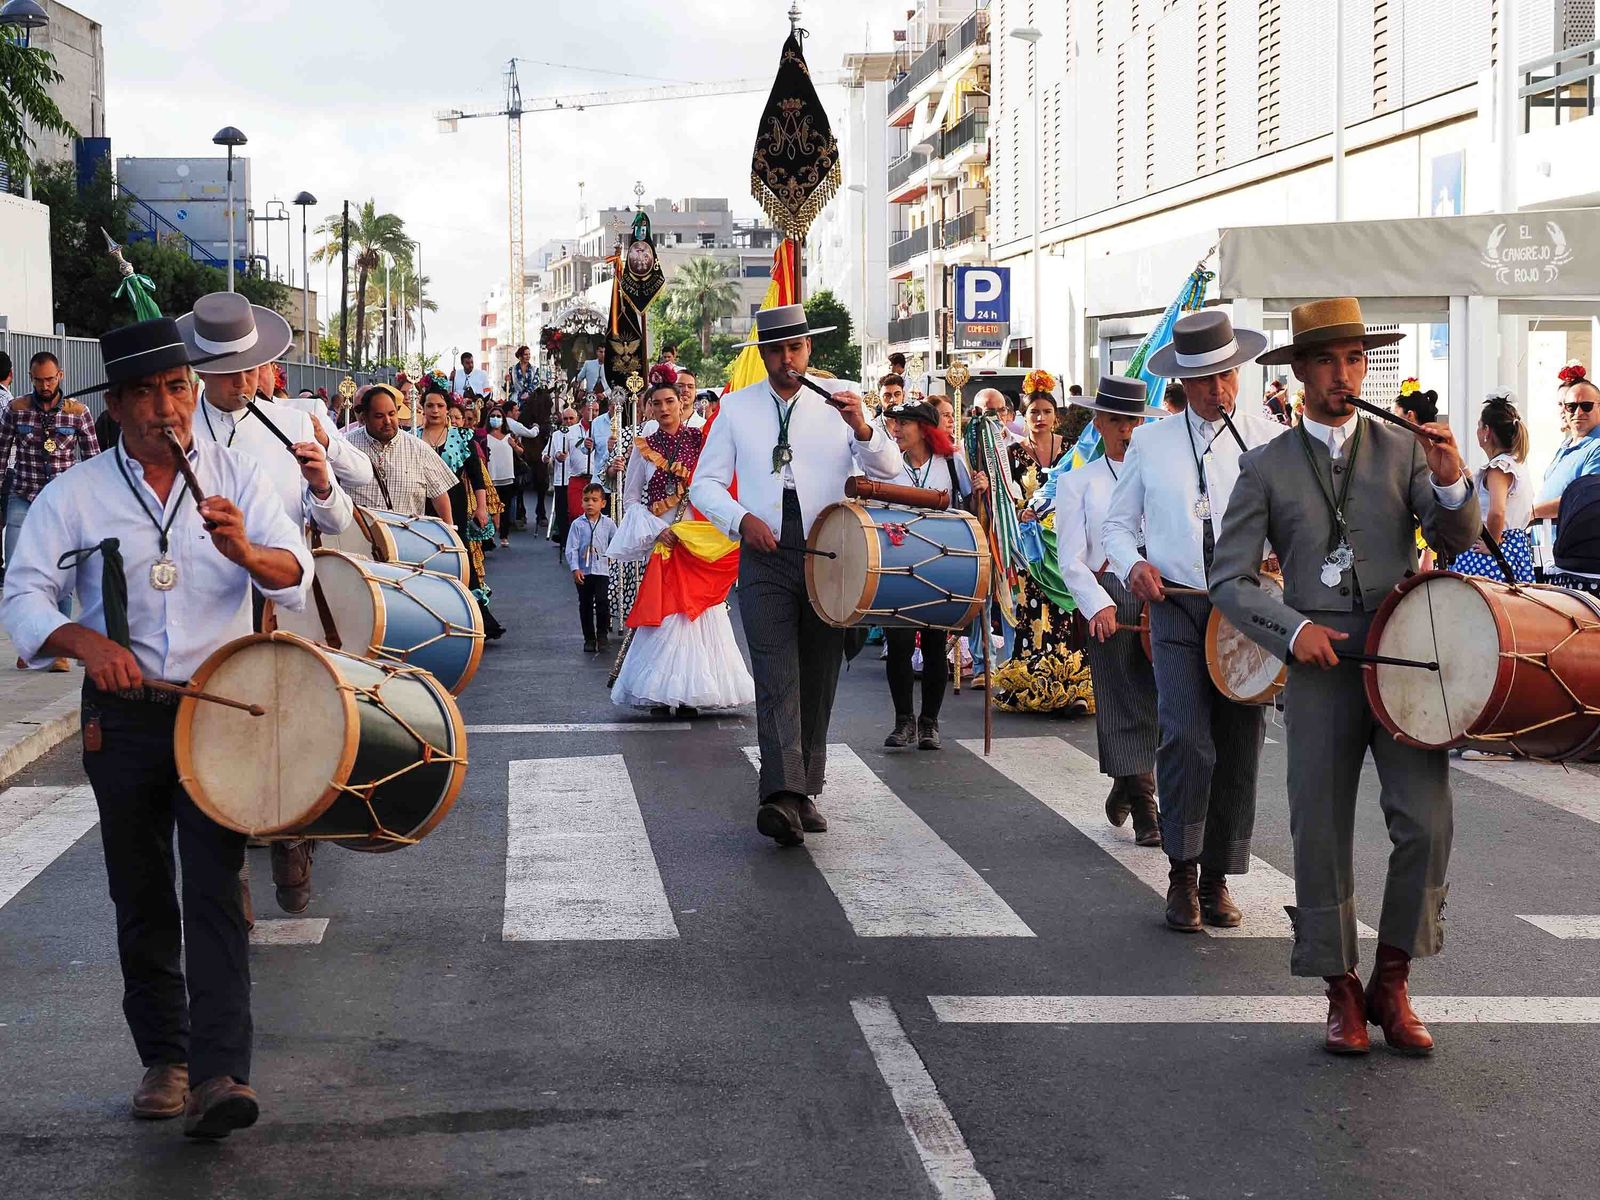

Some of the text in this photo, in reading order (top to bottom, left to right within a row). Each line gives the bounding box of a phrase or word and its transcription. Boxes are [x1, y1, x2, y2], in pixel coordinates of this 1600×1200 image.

[1519, 225, 1532, 239] EL
[1502, 245, 1551, 261] CANGREJO
[1514, 267, 1540, 282] ROJO
[964, 270, 1002, 320] P
[977, 311, 997, 319] 24 h
[967, 325, 999, 333] COMPLETO
[962, 339, 1002, 347] IberPark
